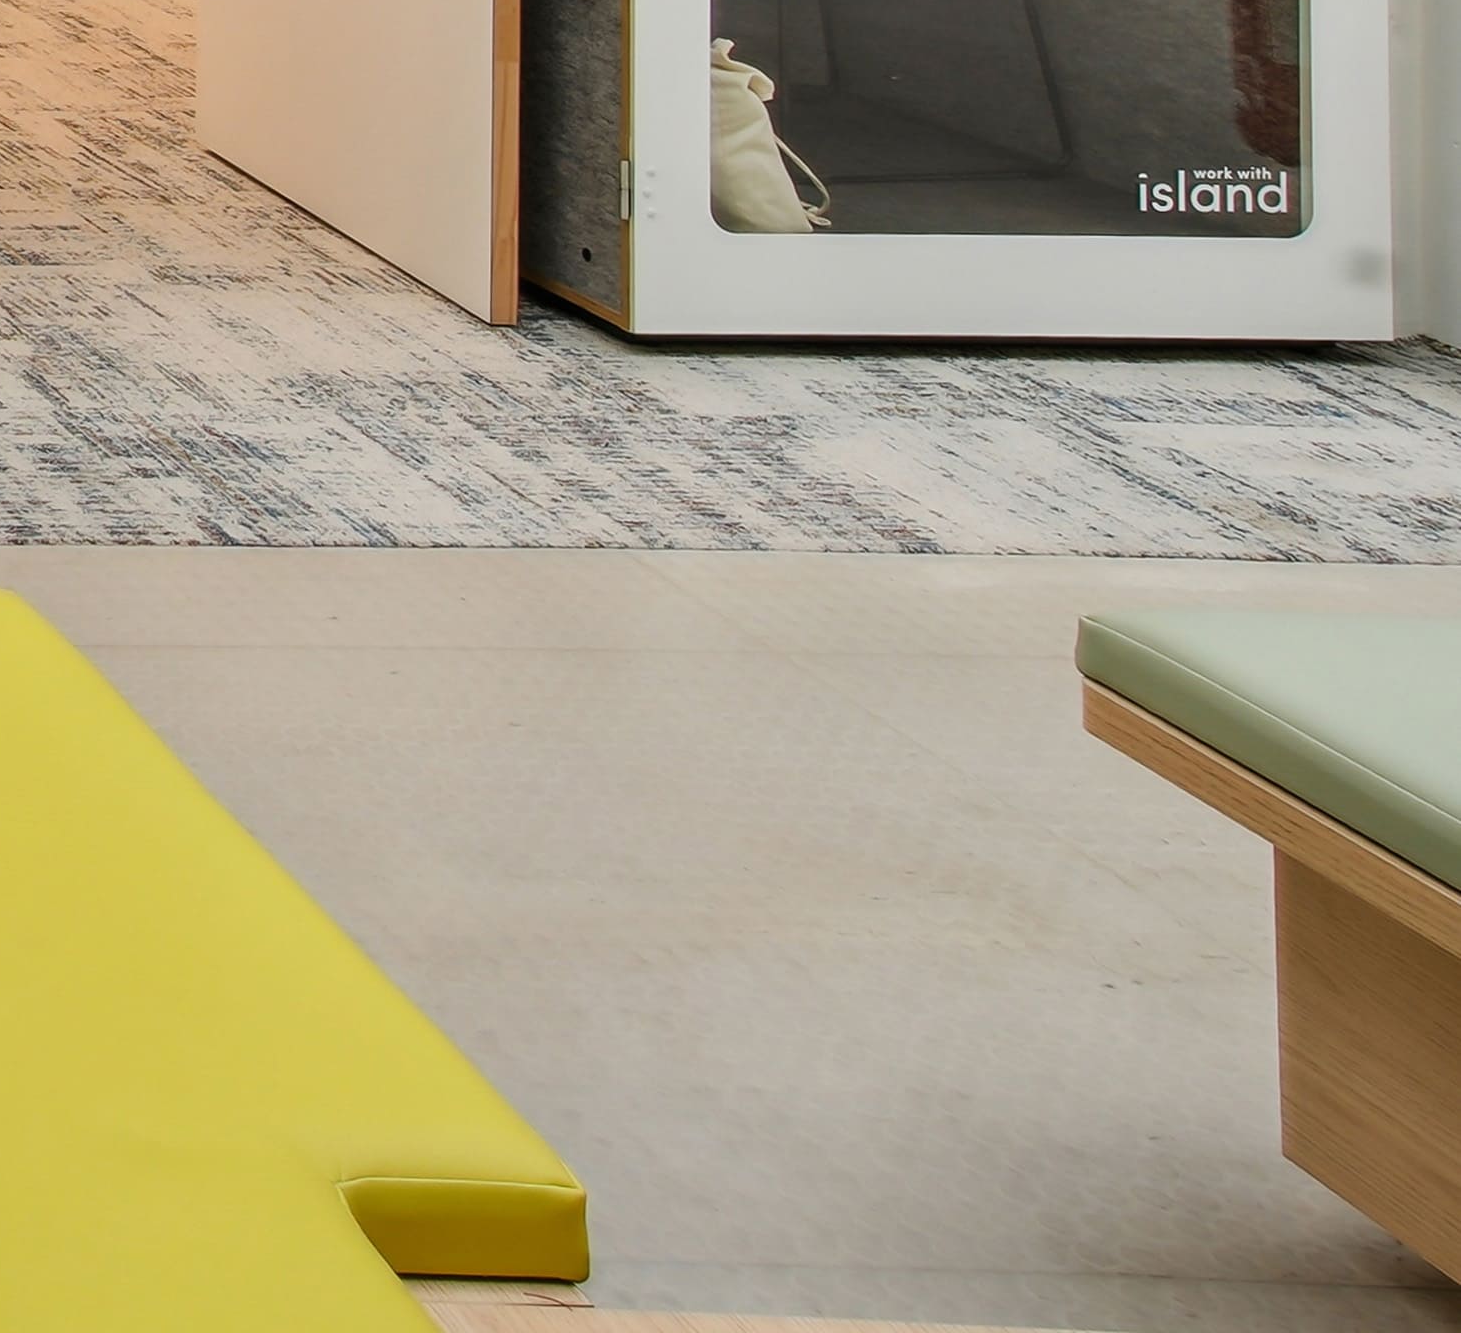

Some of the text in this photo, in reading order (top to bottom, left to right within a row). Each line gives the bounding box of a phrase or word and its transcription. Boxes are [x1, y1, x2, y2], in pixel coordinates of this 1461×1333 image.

[1193, 166, 1272, 180] work with
[1137, 170, 1289, 214] island
